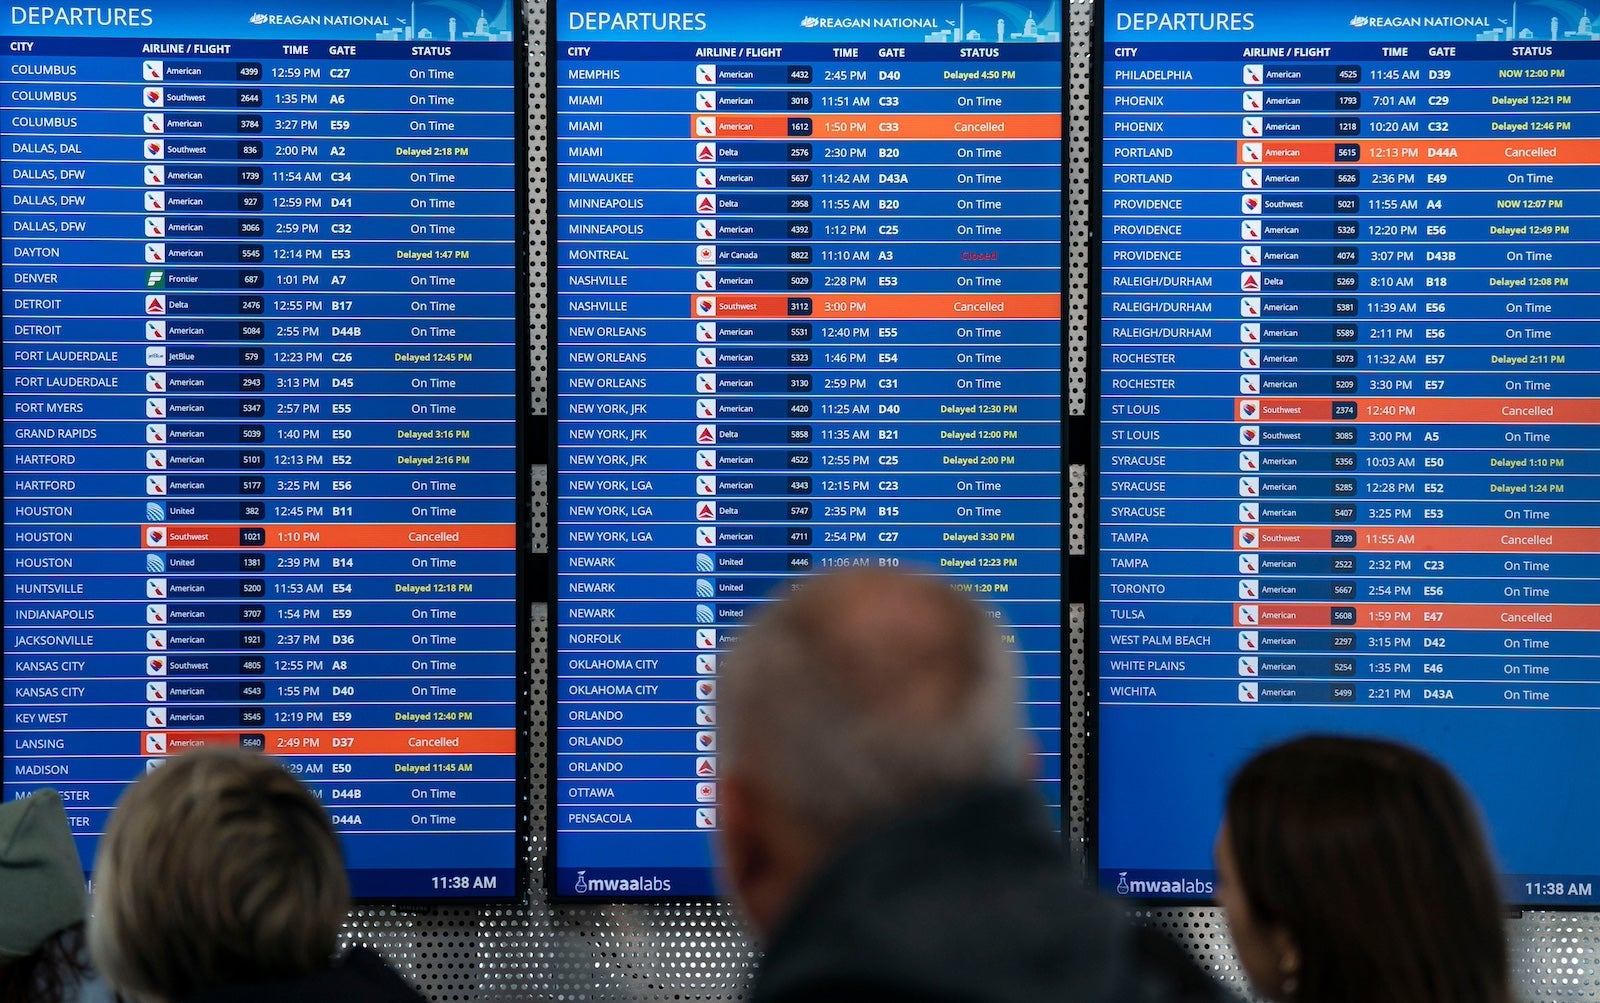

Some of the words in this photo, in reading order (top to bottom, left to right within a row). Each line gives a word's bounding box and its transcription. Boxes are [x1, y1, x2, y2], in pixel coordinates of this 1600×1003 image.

[12, 7, 153, 26] DEPARTURES
[267, 15, 320, 25] REAGAN
[324, 16, 389, 25] NATIONAL
[570, 12, 706, 30] DEPARTURES
[1117, 13, 1254, 30] DEPARTURES
[1369, 17, 1421, 27] REAGAN
[1424, 17, 1490, 27] NATIONAL
[820, 18, 870, 28] REAGAN
[874, 18, 938, 28] NATIONAL
[10, 42, 34, 51] CITY
[142, 44, 184, 53] AIRLINE
[186, 44, 191, 53] /
[194, 44, 231, 54] FLIGHT
[282, 45, 308, 54] TIME
[329, 46, 356, 55] GATE
[412, 46, 451, 56] STATUS
[568, 47, 591, 56] CITY
[695, 48, 736, 57] AIRLINE
[738, 48, 744, 57] /
[746, 48, 782, 57] FLIGHT
[833, 48, 858, 57] TIME
[878, 48, 905, 57] GATE
[960, 48, 999, 57] STATUS
[1115, 48, 1138, 57] CITY
[1243, 48, 1284, 57] AIRLINE
[1286, 48, 1292, 57] /
[1294, 48, 1331, 57] FLIGHT
[1382, 47, 1408, 56] TIME
[1429, 47, 1456, 56] GATE
[1512, 47, 1552, 56] STATUS
[11, 64, 76, 75] COLUMBUS
[168, 67, 201, 75] American
[272, 68, 301, 78] 12:59
[304, 68, 320, 78] PM
[330, 69, 350, 78] C27
[409, 69, 425, 79] On
[428, 69, 454, 79] Time
[1115, 70, 1193, 80] PHILADELPHIA
[1339, 70, 1357, 78] 4525
[1370, 70, 1399, 80] 11:45
[1402, 70, 1419, 79] AM
[1429, 70, 1451, 79] D39
[1499, 70, 1523, 78] NOW
[1525, 69, 1548, 78] 12:00
[1550, 69, 1565, 77] PM
[569, 121, 602, 131] MIAMI
[825, 122, 847, 132] 1:50
[850, 122, 866, 132] PM
[878, 122, 899, 132] C33
[954, 122, 1004, 132] Cancelled
[13, 143, 57, 154] DALLAS,
[60, 143, 82, 153] DAL
[168, 145, 206, 153] Southwest
[243, 146, 257, 154] 836
[275, 146, 298, 155] 2:00
[301, 146, 318, 155] PM
[330, 146, 345, 156] A2
[396, 147, 432, 158] Delayed
[434, 147, 452, 156] 2:18
[454, 147, 468, 155] PM
[1114, 148, 1173, 158] PORTLAND
[1370, 148, 1399, 157] 12:13
[1401, 148, 1418, 157] PM
[1428, 148, 1458, 157] D44A
[1505, 147, 1556, 157] Cancelled
[569, 250, 629, 260] MONTREAL
[731, 251, 758, 259] Canada
[822, 251, 850, 260] 11:10
[852, 251, 869, 260] AM
[878, 251, 893, 260] A3
[960, 251, 998, 261] Closed
[1113, 276, 1212, 286] RALEIGH/DURHAM
[1264, 277, 1283, 285] Delta
[1370, 277, 1393, 287] 8:10
[1395, 277, 1413, 286] AM
[1426, 277, 1447, 287] B18
[1489, 277, 1526, 288] Delayed
[1528, 278, 1552, 286] 12:08
[1554, 278, 1568, 286] PM
[15, 351, 44, 361] FORT
[46, 351, 118, 361] LAUDERDALE
[168, 352, 195, 361] JetBlue
[274, 352, 303, 362] 12:23
[306, 352, 322, 362] PM
[332, 353, 352, 362] C26
[395, 353, 430, 363] Delayed
[433, 353, 456, 361] 12:45
[458, 353, 472, 361] PM
[570, 429, 595, 439] NEW
[596, 429, 628, 440] YORK,
[630, 429, 647, 441] JFK
[719, 430, 738, 438] Delta
[821, 430, 850, 439] 11:35
[852, 430, 869, 439] AM
[879, 430, 898, 439] B21
[941, 430, 976, 441] Delayed
[978, 431, 1001, 439] 12:00
[16, 532, 72, 542] HOUSTON
[278, 532, 300, 541] 1:10
[303, 532, 320, 541] PM
[408, 532, 459, 542] Cancelled
[1110, 609, 1145, 619] TULSA
[1263, 611, 1296, 619] American
[1369, 611, 1391, 621] 1:59
[1394, 612, 1411, 621] PM
[1424, 612, 1443, 621] E47
[1500, 612, 1552, 622] Cancelled
[569, 634, 621, 644] NORFOLK
[569, 685, 633, 695] OKLAHOMA
[635, 685, 658, 695] CITY
[1110, 686, 1157, 696] WICHITA
[1263, 688, 1296, 696] American
[1336, 689, 1352, 697] 5499
[1368, 689, 1389, 698] 2:21
[1394, 689, 1410, 698] PM
[1424, 689, 1454, 699] D43A
[1504, 690, 1520, 700] On
[1522, 690, 1549, 700] Time
[16, 739, 64, 749] LANSING
[169, 739, 205, 747] American
[277, 738, 300, 747] 2:49
[303, 738, 319, 747] PM
[332, 737, 354, 747] D37
[408, 737, 459, 747] Cancelled
[569, 736, 623, 746] ORLANDO
[569, 788, 615, 797] OTTAWA
[569, 814, 632, 823] PENSACOLA
[432, 876, 469, 889] 11:38
[473, 876, 496, 888] AM
[588, 876, 671, 891] mwaalabs
[1130, 878, 1213, 893] mwaalabs
[1526, 883, 1564, 895] 11:38
[1567, 883, 1592, 895] AM
